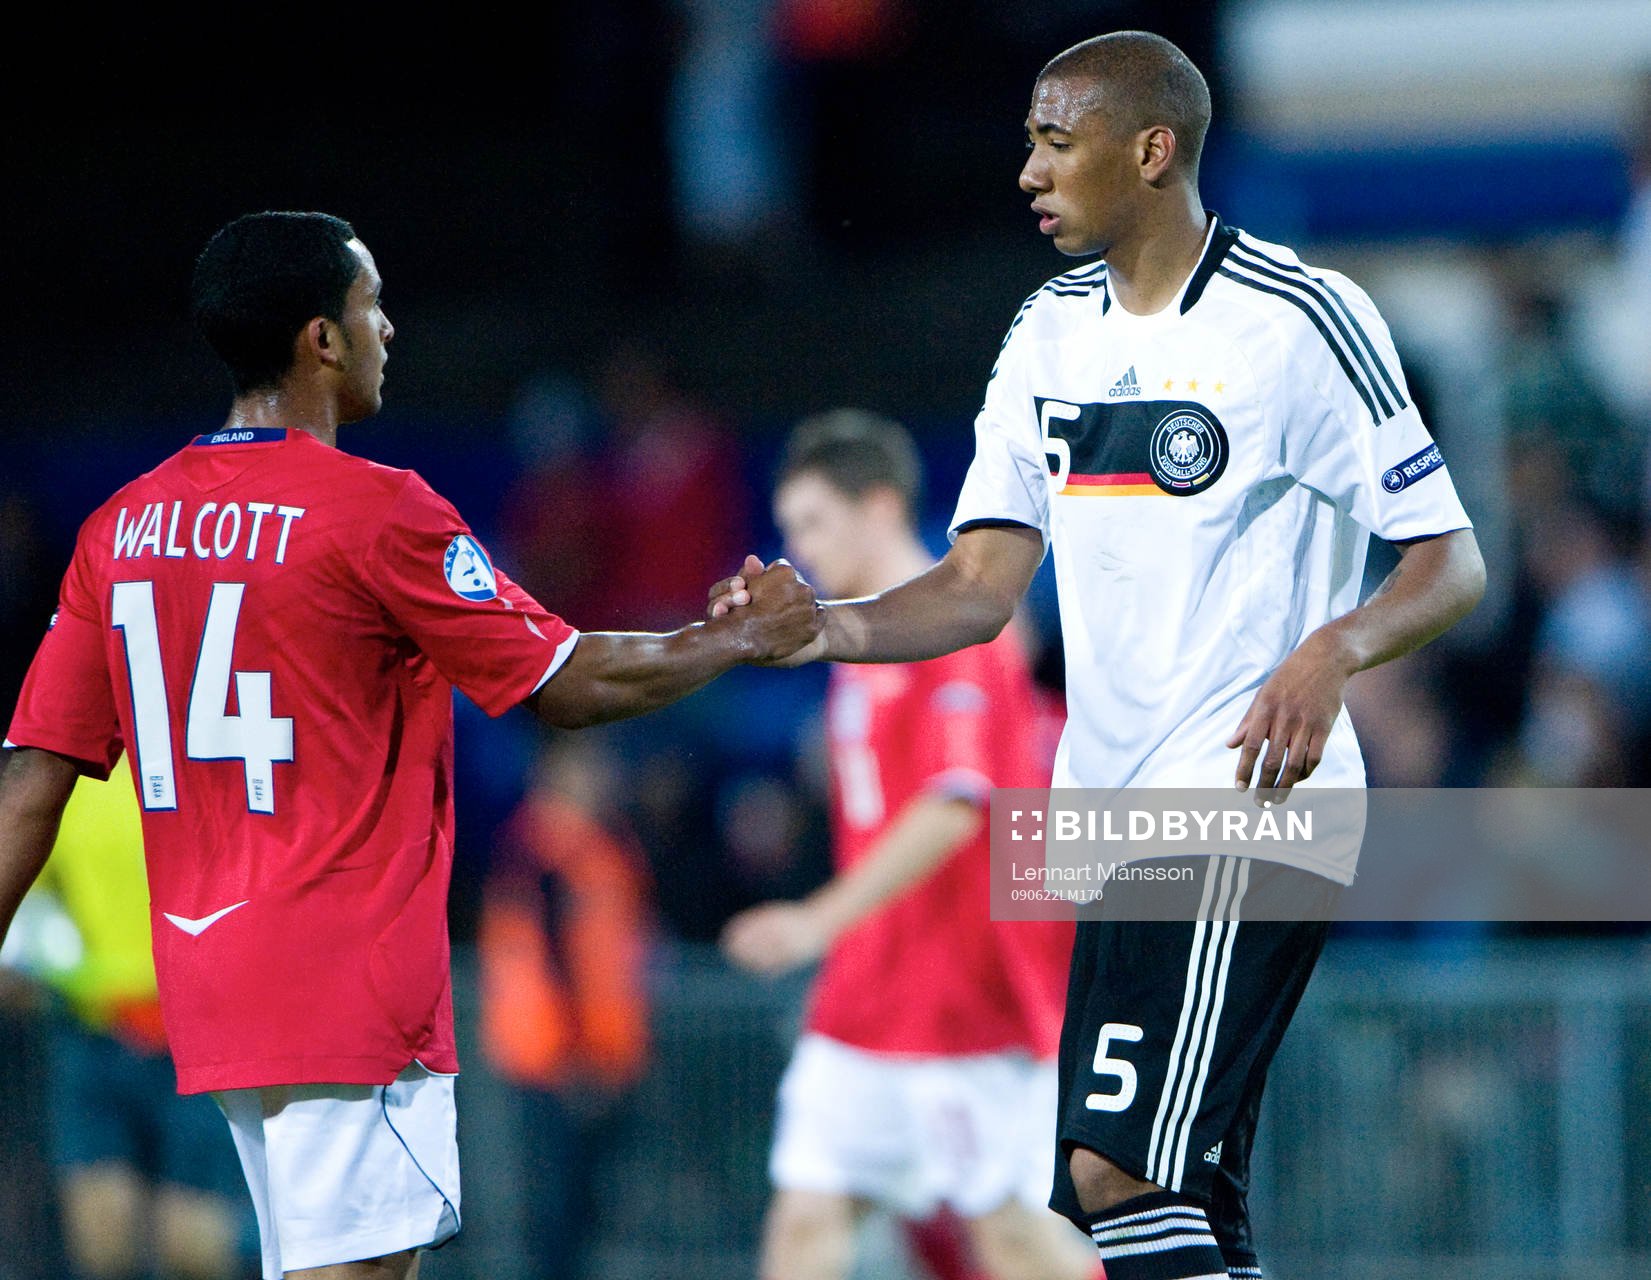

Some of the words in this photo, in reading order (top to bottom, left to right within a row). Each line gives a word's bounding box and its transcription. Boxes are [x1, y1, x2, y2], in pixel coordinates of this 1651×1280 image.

[1108, 386, 1142, 397] adidas
[1166, 418, 1205, 434] DEUTSCHER
[1040, 400, 1081, 494] 5
[113, 500, 306, 565] WALCOTT
[112, 580, 295, 815] 14
[1085, 1023, 1144, 1112] 5
